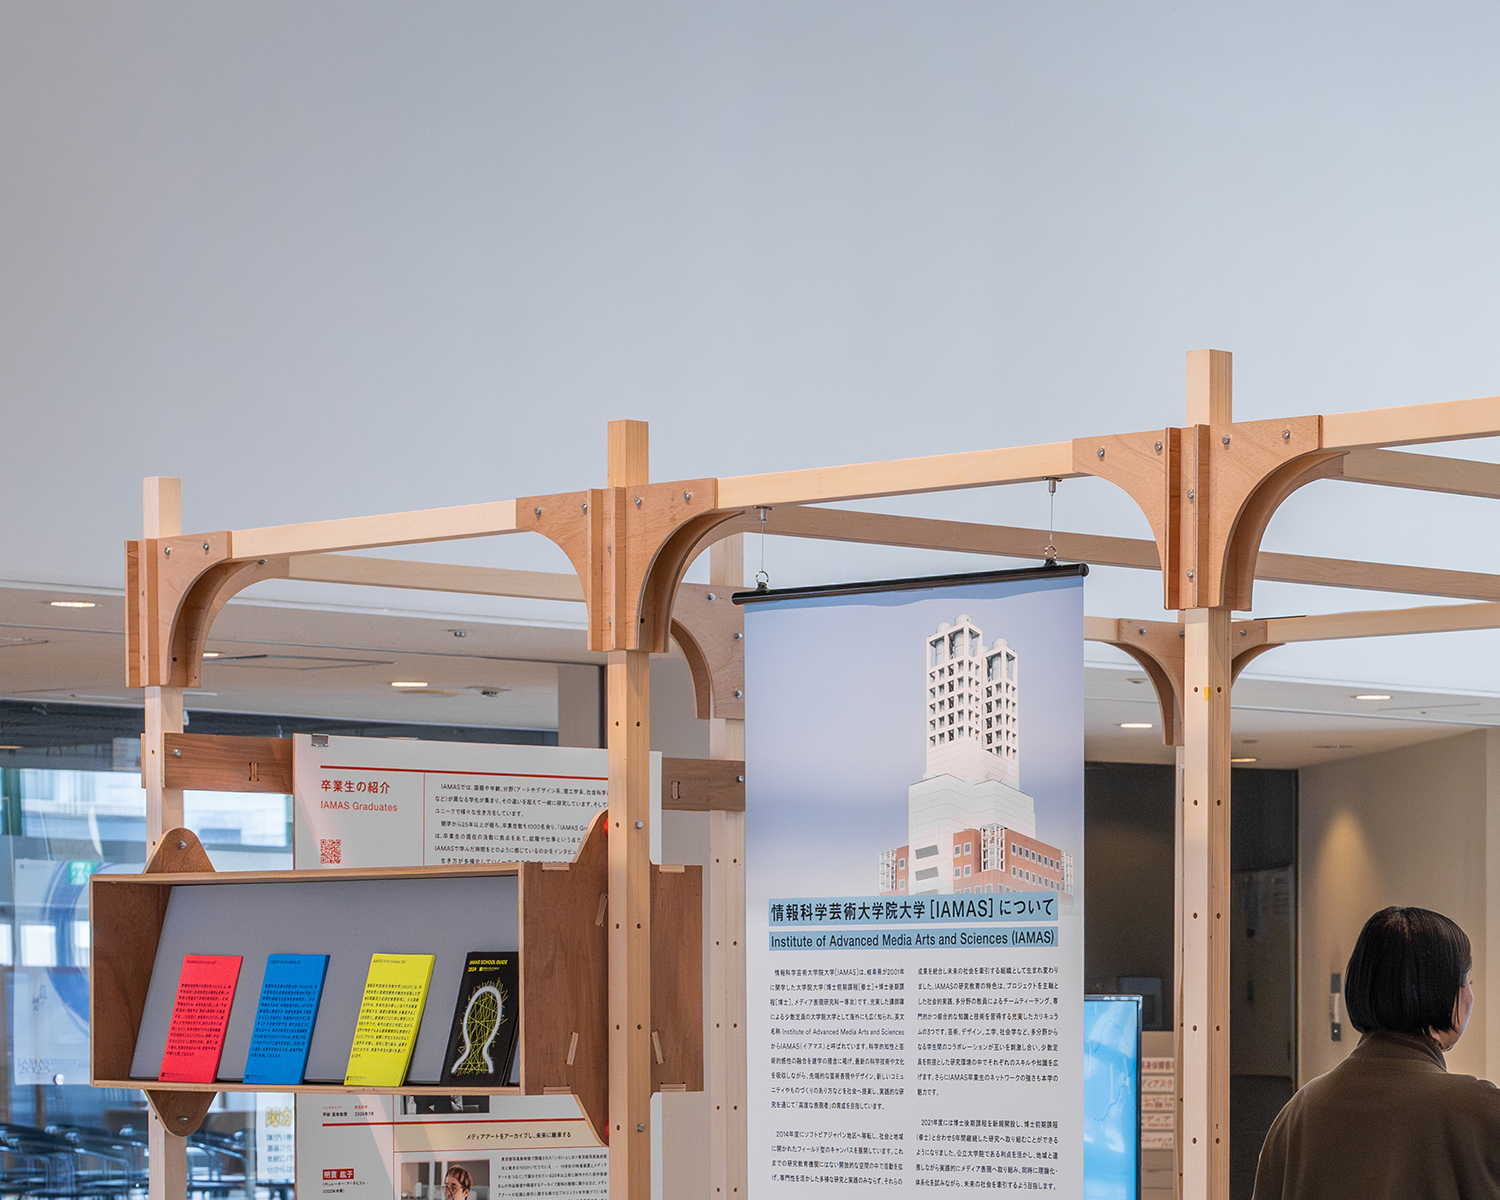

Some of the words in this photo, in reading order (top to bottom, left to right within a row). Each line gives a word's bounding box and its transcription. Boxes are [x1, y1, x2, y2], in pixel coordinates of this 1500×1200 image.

[320, 778, 390, 794] 卒業生の紹介
[320, 800, 350, 810] IAMAS
[352, 802, 398, 812] Graduates
[771, 901, 926, 922] 情報科学芸術大学院大学
[930, 898, 994, 920] [IAMAS]
[999, 897, 1055, 916] について
[771, 933, 814, 948] Institute
[817, 933, 828, 947] of
[830, 932, 879, 947] Advanced
[882, 932, 913, 947] Media
[915, 931, 936, 946] Arts
[938, 931, 957, 945] and
[960, 930, 1008, 945] Sciences
[1011, 929, 1055, 945] (IAMAS)
[918, 1088, 939, 1096] 魅力です。
